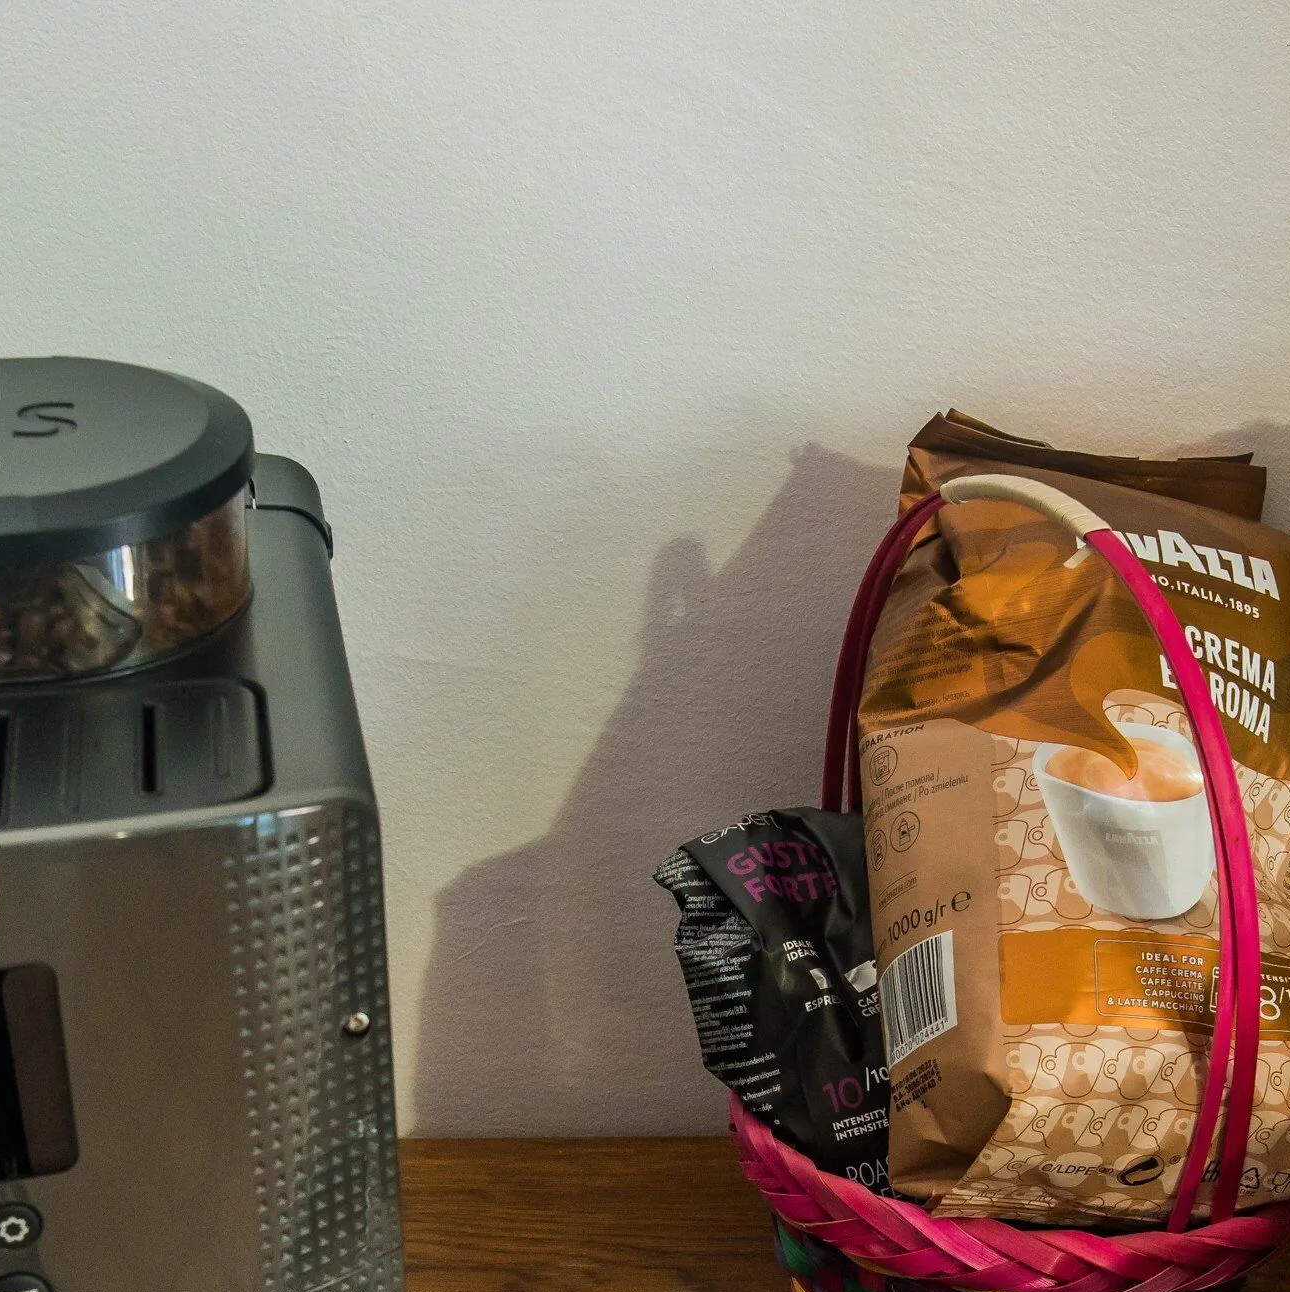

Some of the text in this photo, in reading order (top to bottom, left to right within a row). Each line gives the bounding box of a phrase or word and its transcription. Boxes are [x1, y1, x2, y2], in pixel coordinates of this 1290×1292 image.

[1076, 529, 1281, 601] VAZZA
[1229, 597, 1260, 619] 1895
[1184, 625, 1276, 700] CREMA
[1209, 671, 1271, 744] ROMA
[860, 724, 925, 756] EPARATION
[743, 870, 838, 903] FORTE
[887, 909, 921, 945] 1000
[1141, 952, 1204, 966] IDEAL FOR
[1171, 968, 1205, 981] CREMA,
[1175, 979, 1205, 992] LATTE,
[805, 995, 843, 1012] ESPRE
[857, 991, 879, 1008] CAF
[1107, 997, 1204, 1014] & LATTE MACCHIATO
[1144, 988, 1205, 1002] CAPPUCCINO
[832, 1107, 887, 1131] INTENSITY
[835, 1117, 890, 1141] INTENSITÉ
[846, 1158, 889, 1187] ROA
